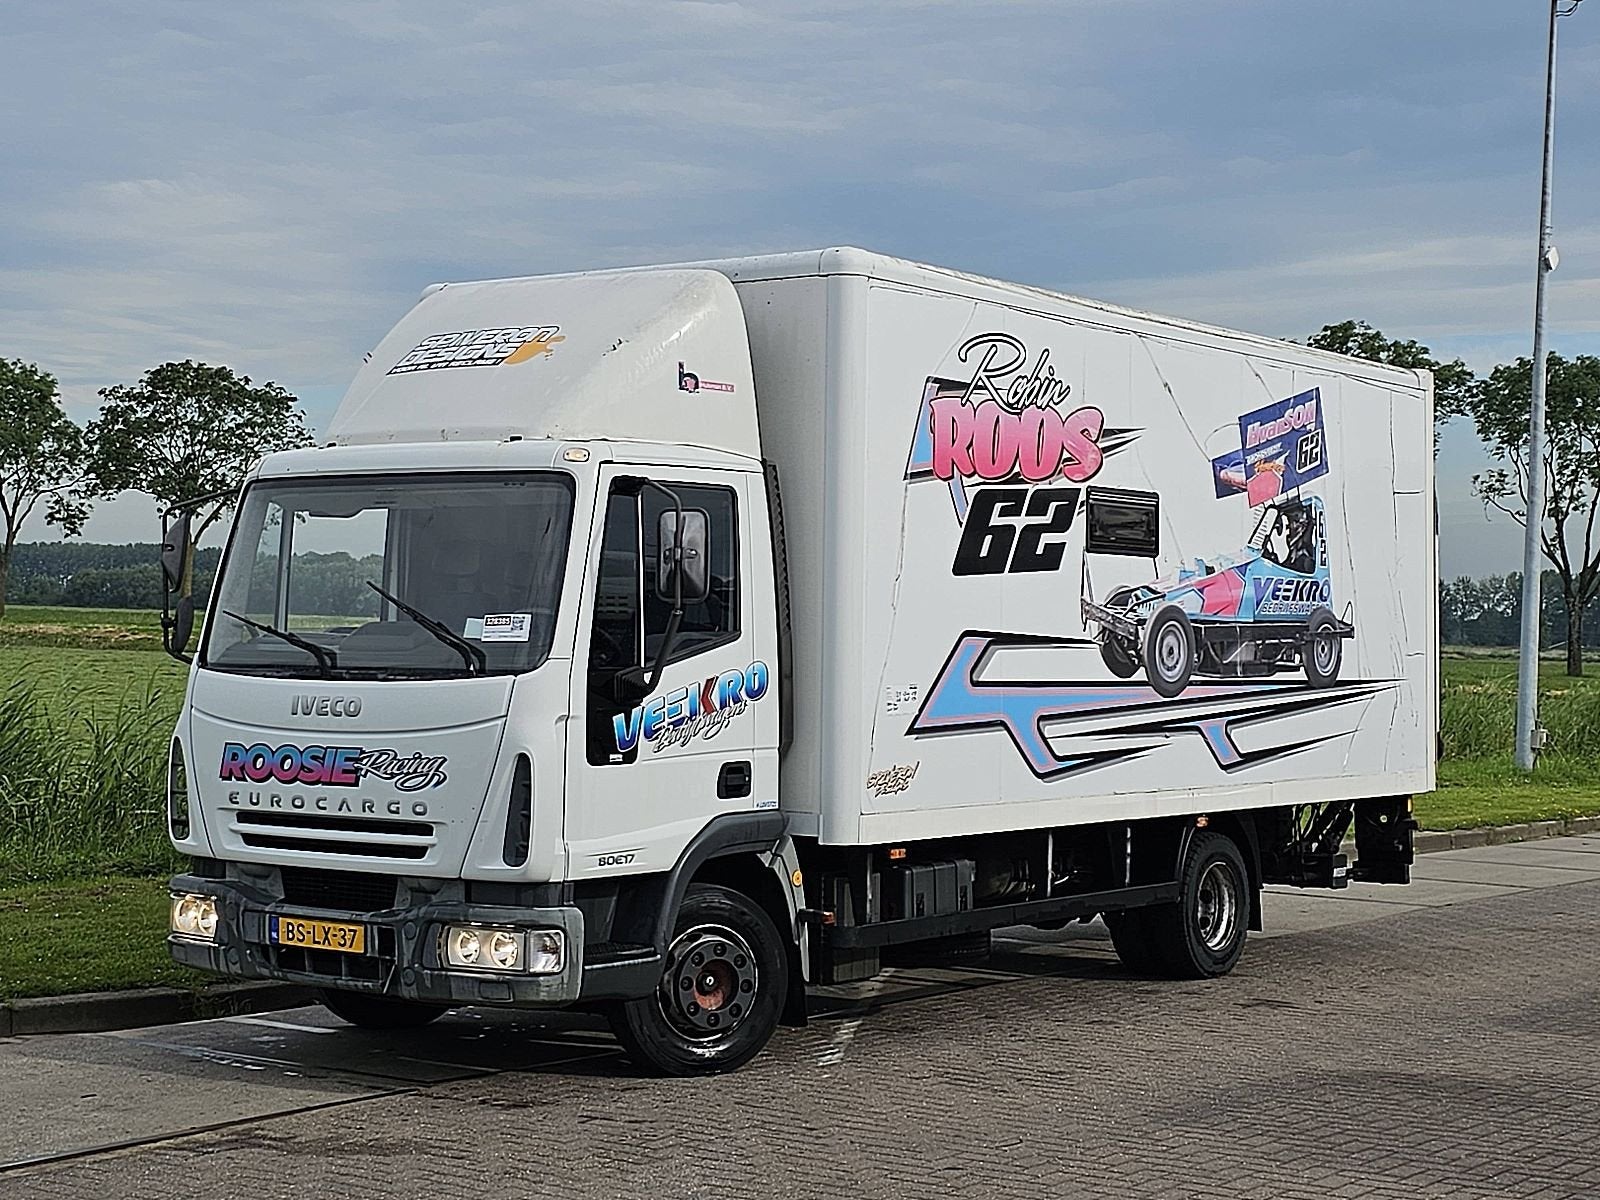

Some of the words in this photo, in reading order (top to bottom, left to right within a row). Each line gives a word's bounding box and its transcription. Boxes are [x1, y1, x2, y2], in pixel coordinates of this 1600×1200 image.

[397, 342, 520, 366] DESIGNS
[958, 333, 1071, 414] Robin
[929, 396, 1104, 484] ROOS
[1297, 430, 1321, 473] 62
[952, 487, 1081, 576] 62
[1252, 577, 1331, 613] VEEKRO
[291, 695, 362, 717] IVECO
[612, 660, 769, 752] VEEKRO
[220, 742, 362, 787] ROOSIE
[354, 749, 448, 791] Racing
[229, 791, 428, 817] EUROCARGO
[286, 921, 358, 949] BS-LX-37
